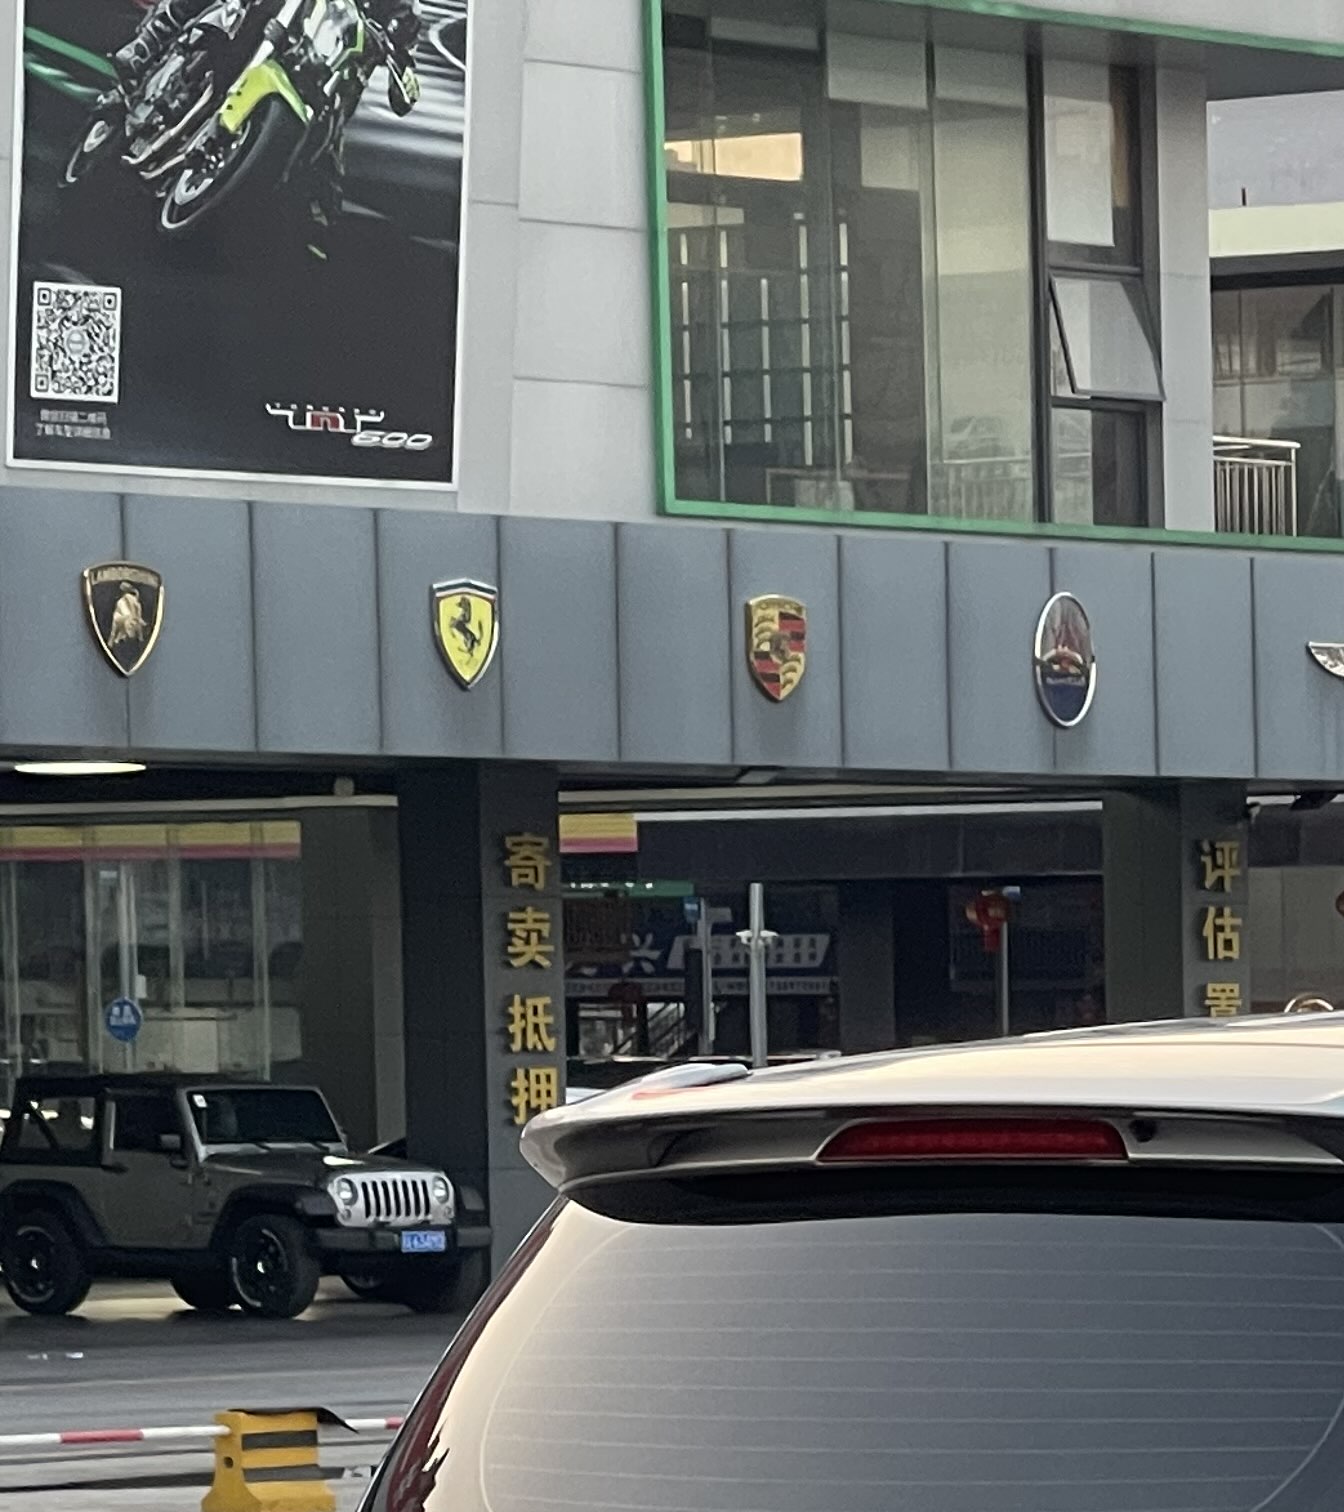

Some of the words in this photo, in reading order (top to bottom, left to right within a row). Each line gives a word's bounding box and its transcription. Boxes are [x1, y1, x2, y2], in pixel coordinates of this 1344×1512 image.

[351, 430, 432, 450] 600
[504, 832, 558, 1125] 寄卖抵押
